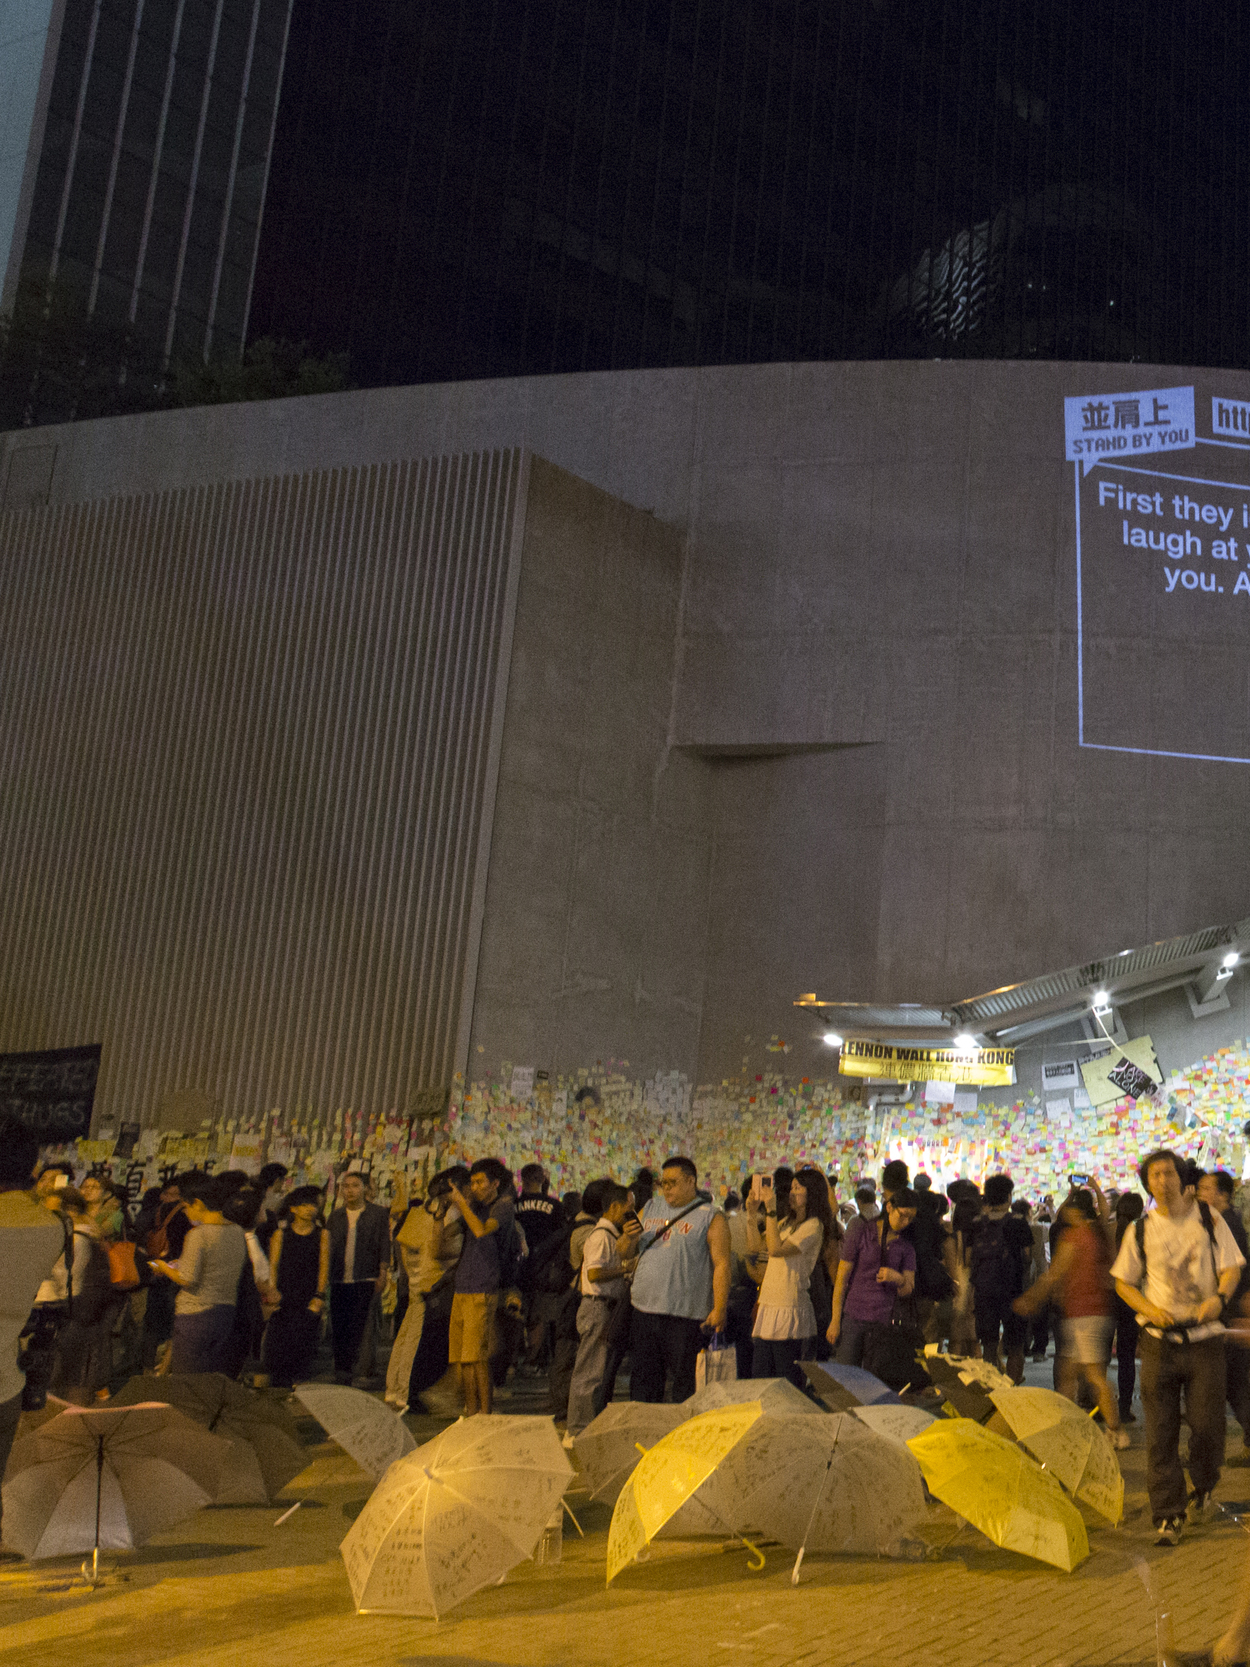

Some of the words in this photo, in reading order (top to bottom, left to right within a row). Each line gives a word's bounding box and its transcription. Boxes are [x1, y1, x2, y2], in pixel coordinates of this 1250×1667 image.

[1082, 397, 1171, 432] 並肩上
[1073, 436, 1127, 454] STAND
[1132, 432, 1153, 448] BY
[1158, 429, 1190, 446] YOU
[1098, 481, 1164, 517] First
[1172, 494, 1234, 531] they
[1123, 520, 1203, 559] laugh
[1211, 537, 1239, 561] at
[1164, 566, 1224, 593] you.
[897, 1047, 932, 1062] WALL
[977, 1051, 1015, 1066] KONG
